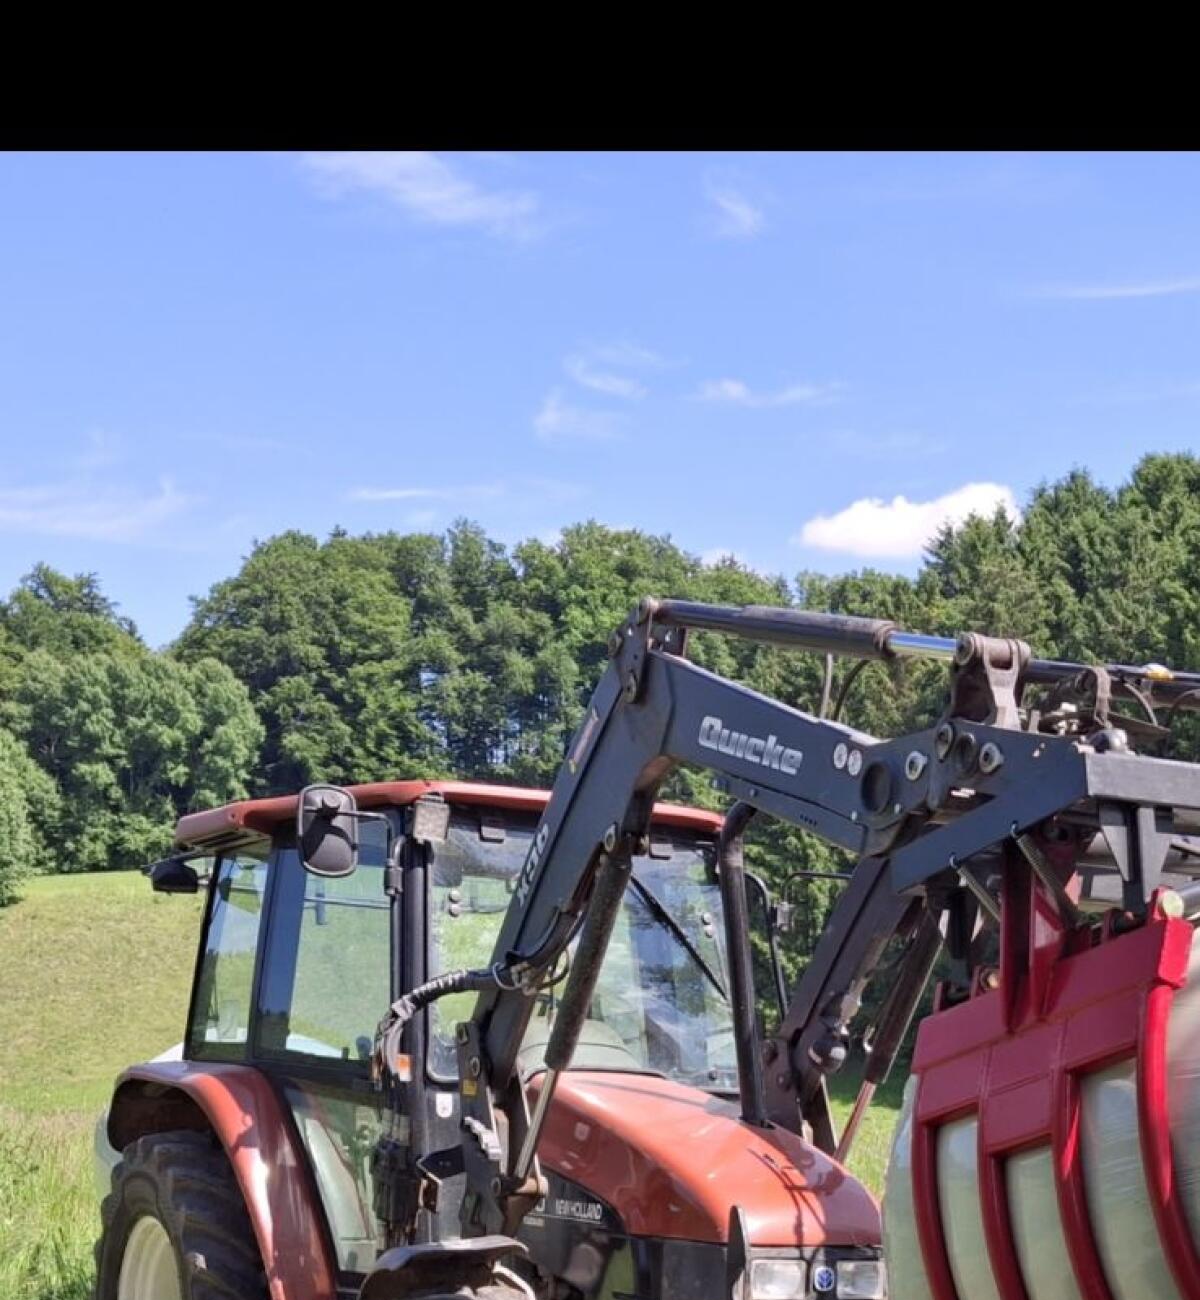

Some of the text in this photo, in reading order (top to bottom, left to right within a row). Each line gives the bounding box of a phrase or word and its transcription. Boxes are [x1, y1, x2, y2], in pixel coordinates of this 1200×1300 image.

[699, 716, 803, 775] Quicke
[555, 1199, 570, 1216] NEW
[570, 1200, 602, 1220] HOLLAND
